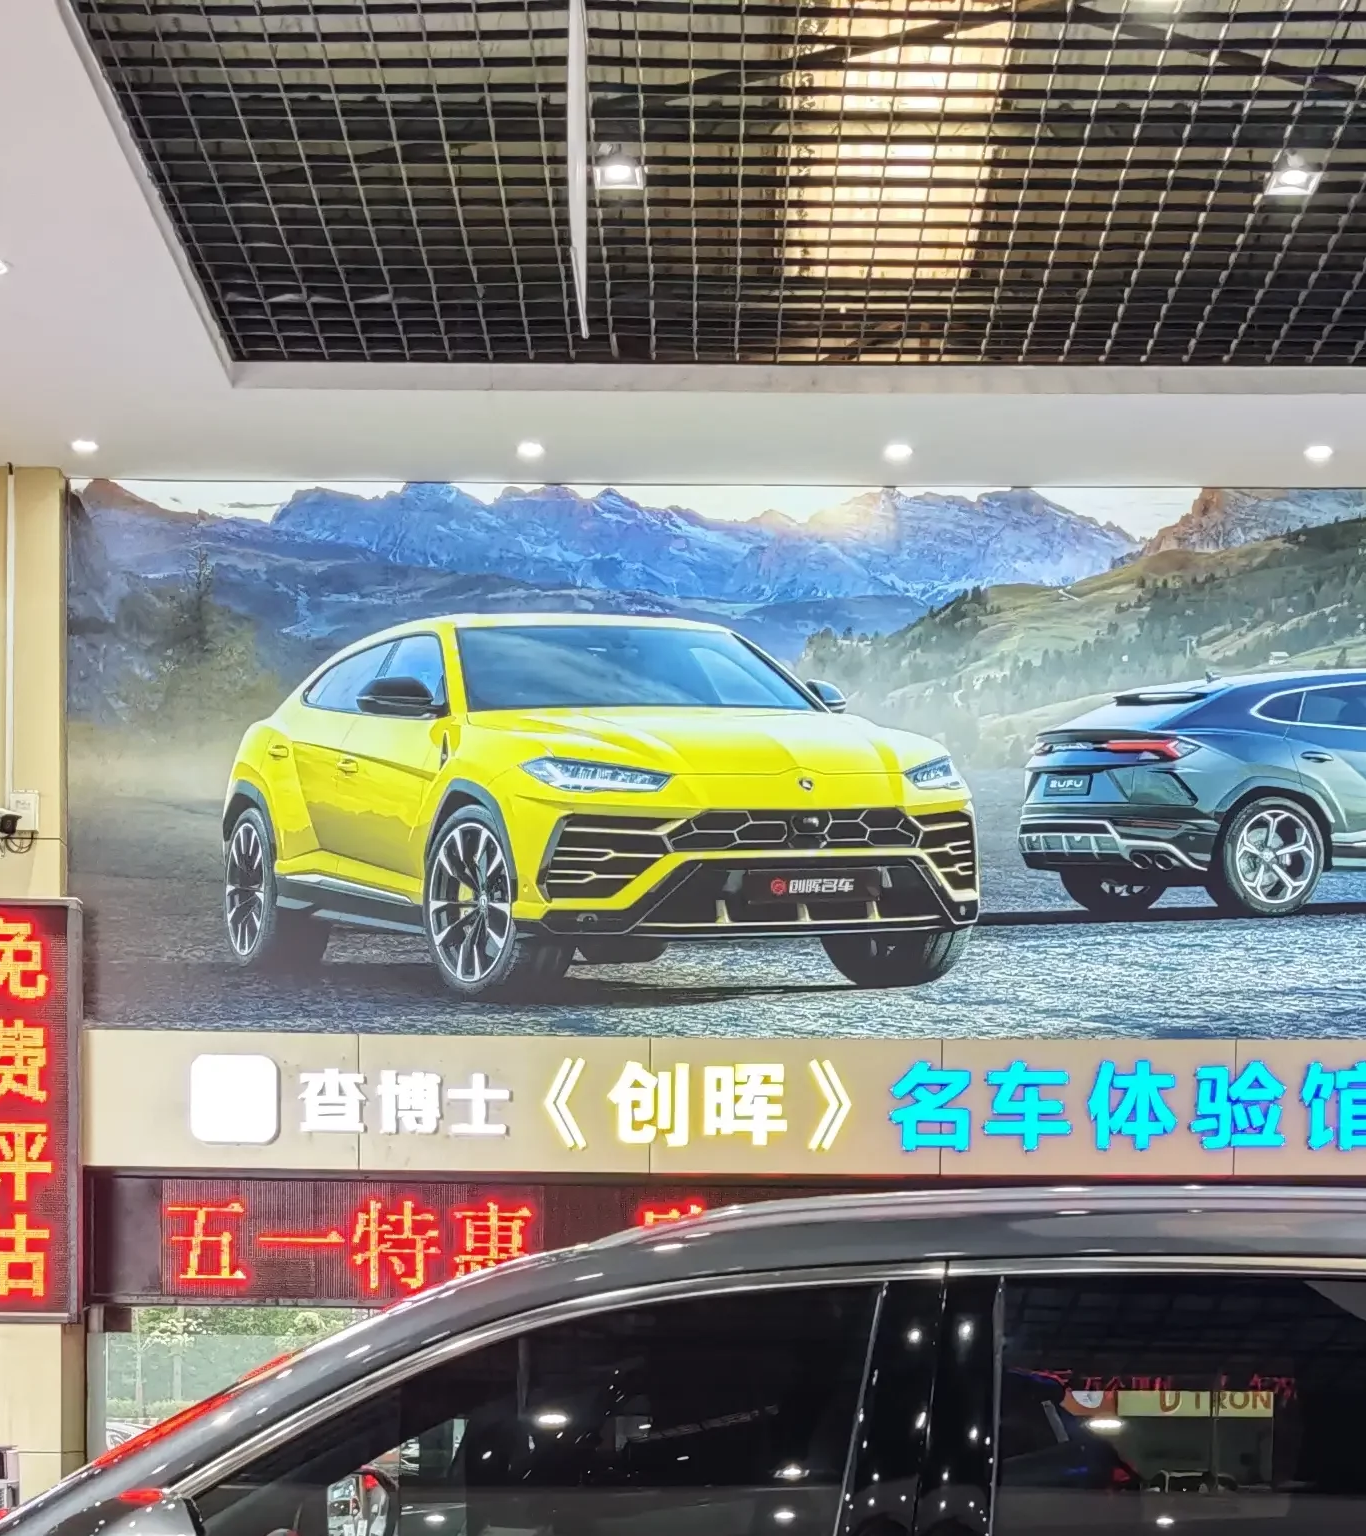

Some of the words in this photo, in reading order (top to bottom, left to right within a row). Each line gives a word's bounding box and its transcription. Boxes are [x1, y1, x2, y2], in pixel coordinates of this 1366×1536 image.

[788, 878, 855, 894] 创晖名车
[298, 1067, 514, 1138] 查博士
[164, 1200, 535, 1292] 五一特惠
